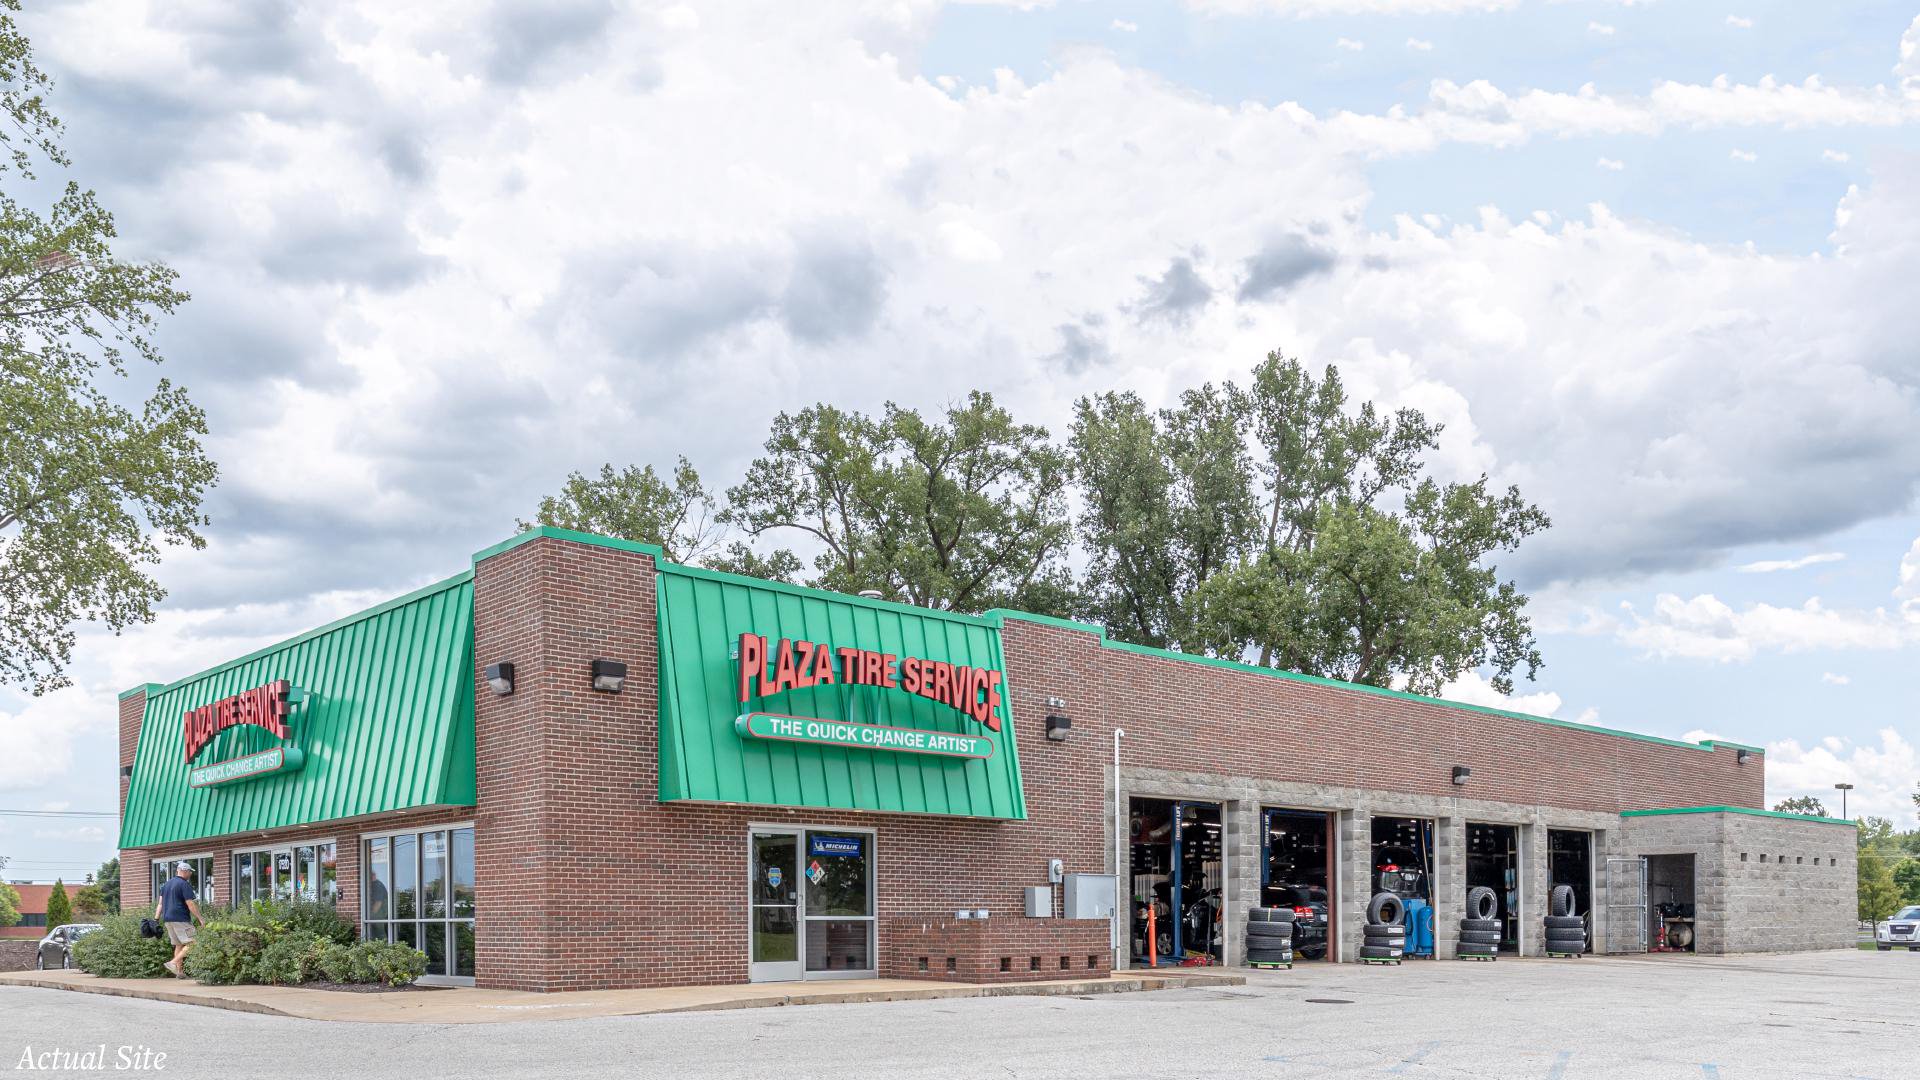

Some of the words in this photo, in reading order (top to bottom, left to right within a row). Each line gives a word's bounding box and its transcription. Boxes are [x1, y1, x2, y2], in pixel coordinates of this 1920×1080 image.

[740, 632, 835, 703] PLAZA
[837, 646, 897, 688] TIRE
[902, 656, 1001, 732] SERVICE
[184, 704, 216, 764] PLAZA
[215, 695, 238, 731] TIRE
[238, 679, 287, 740] SERVICE
[770, 718, 803, 737] THE
[807, 723, 858, 743] QUICK
[861, 728, 925, 748] CHANGE
[928, 736, 977, 753] ARTIST
[193, 770, 205, 784] THE
[205, 765, 226, 781] QUICK
[226, 760, 253, 777] CHANGE
[254, 752, 279, 770] ARTIST
[825, 843, 858, 851] MICHELIN
